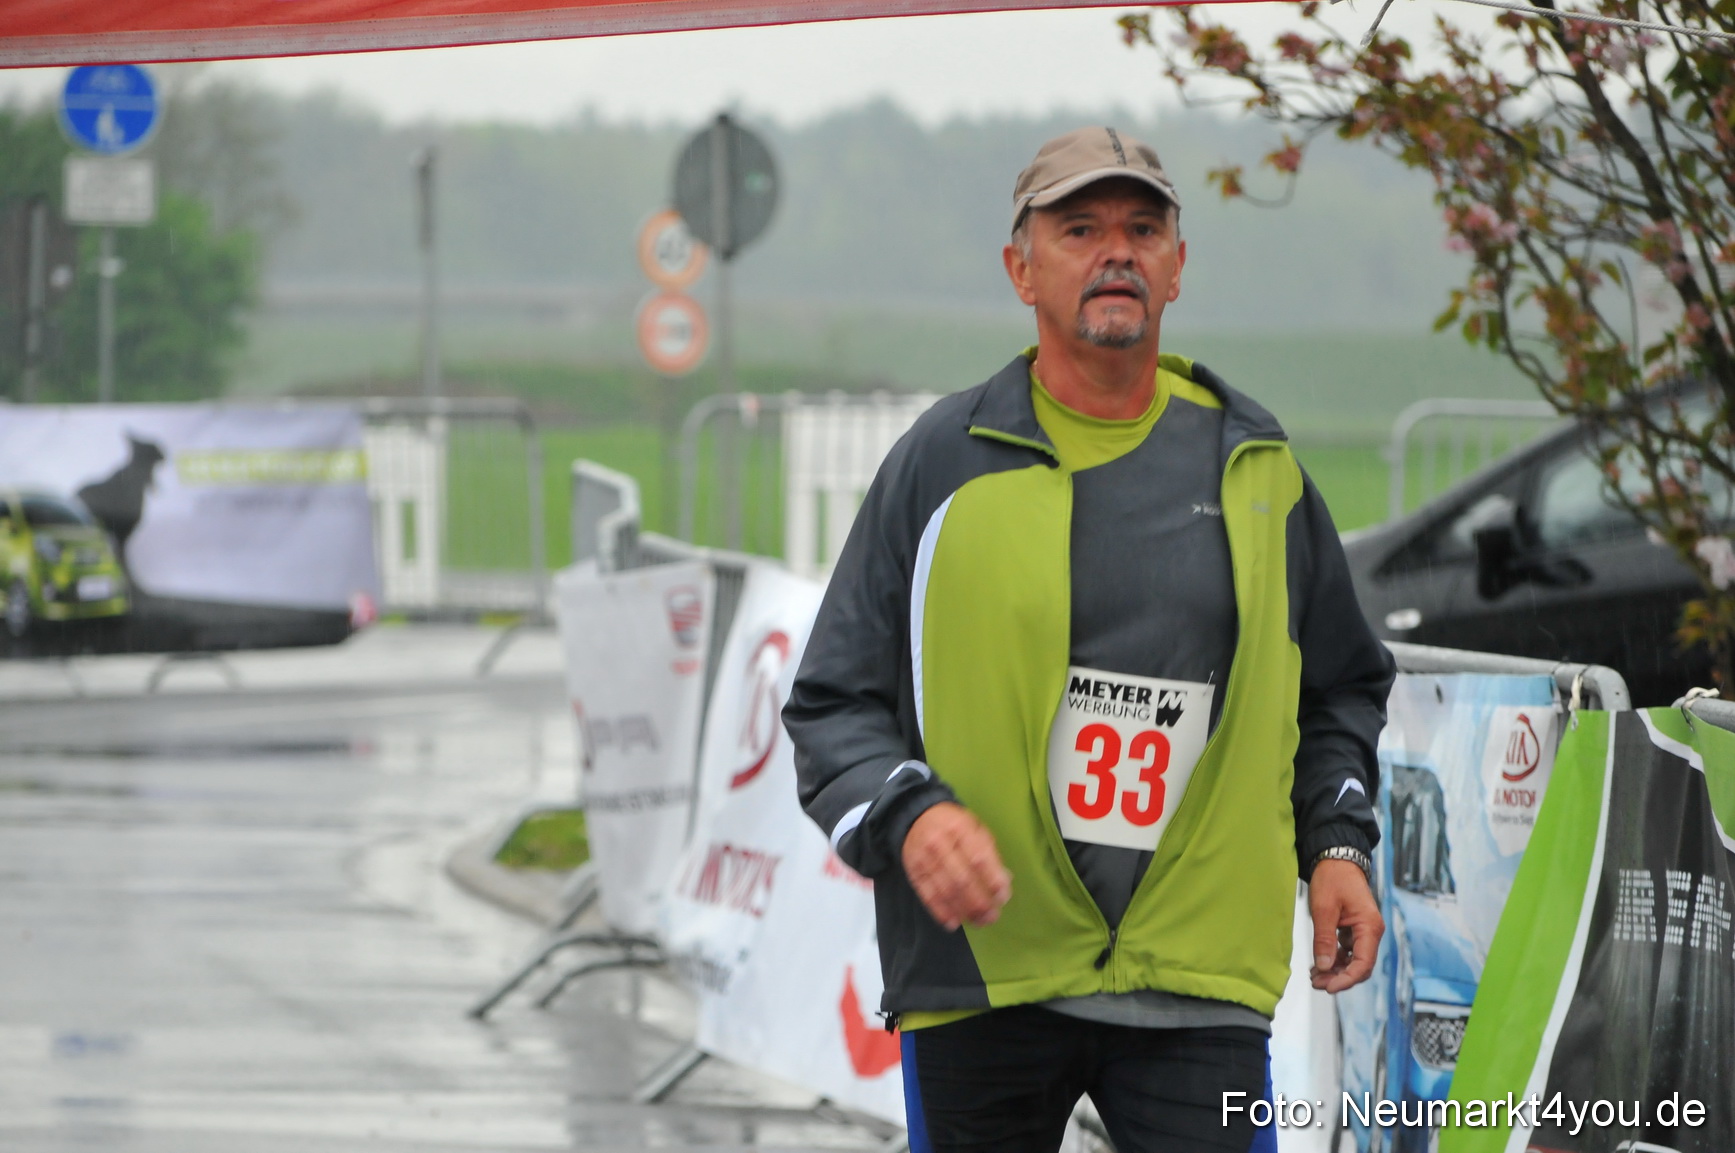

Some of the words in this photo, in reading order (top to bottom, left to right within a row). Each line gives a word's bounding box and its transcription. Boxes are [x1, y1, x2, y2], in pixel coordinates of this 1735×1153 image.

[1068, 676, 1152, 705] MEYER
[1068, 696, 1151, 721] WERBUNG
[1067, 723, 1171, 827] 33
